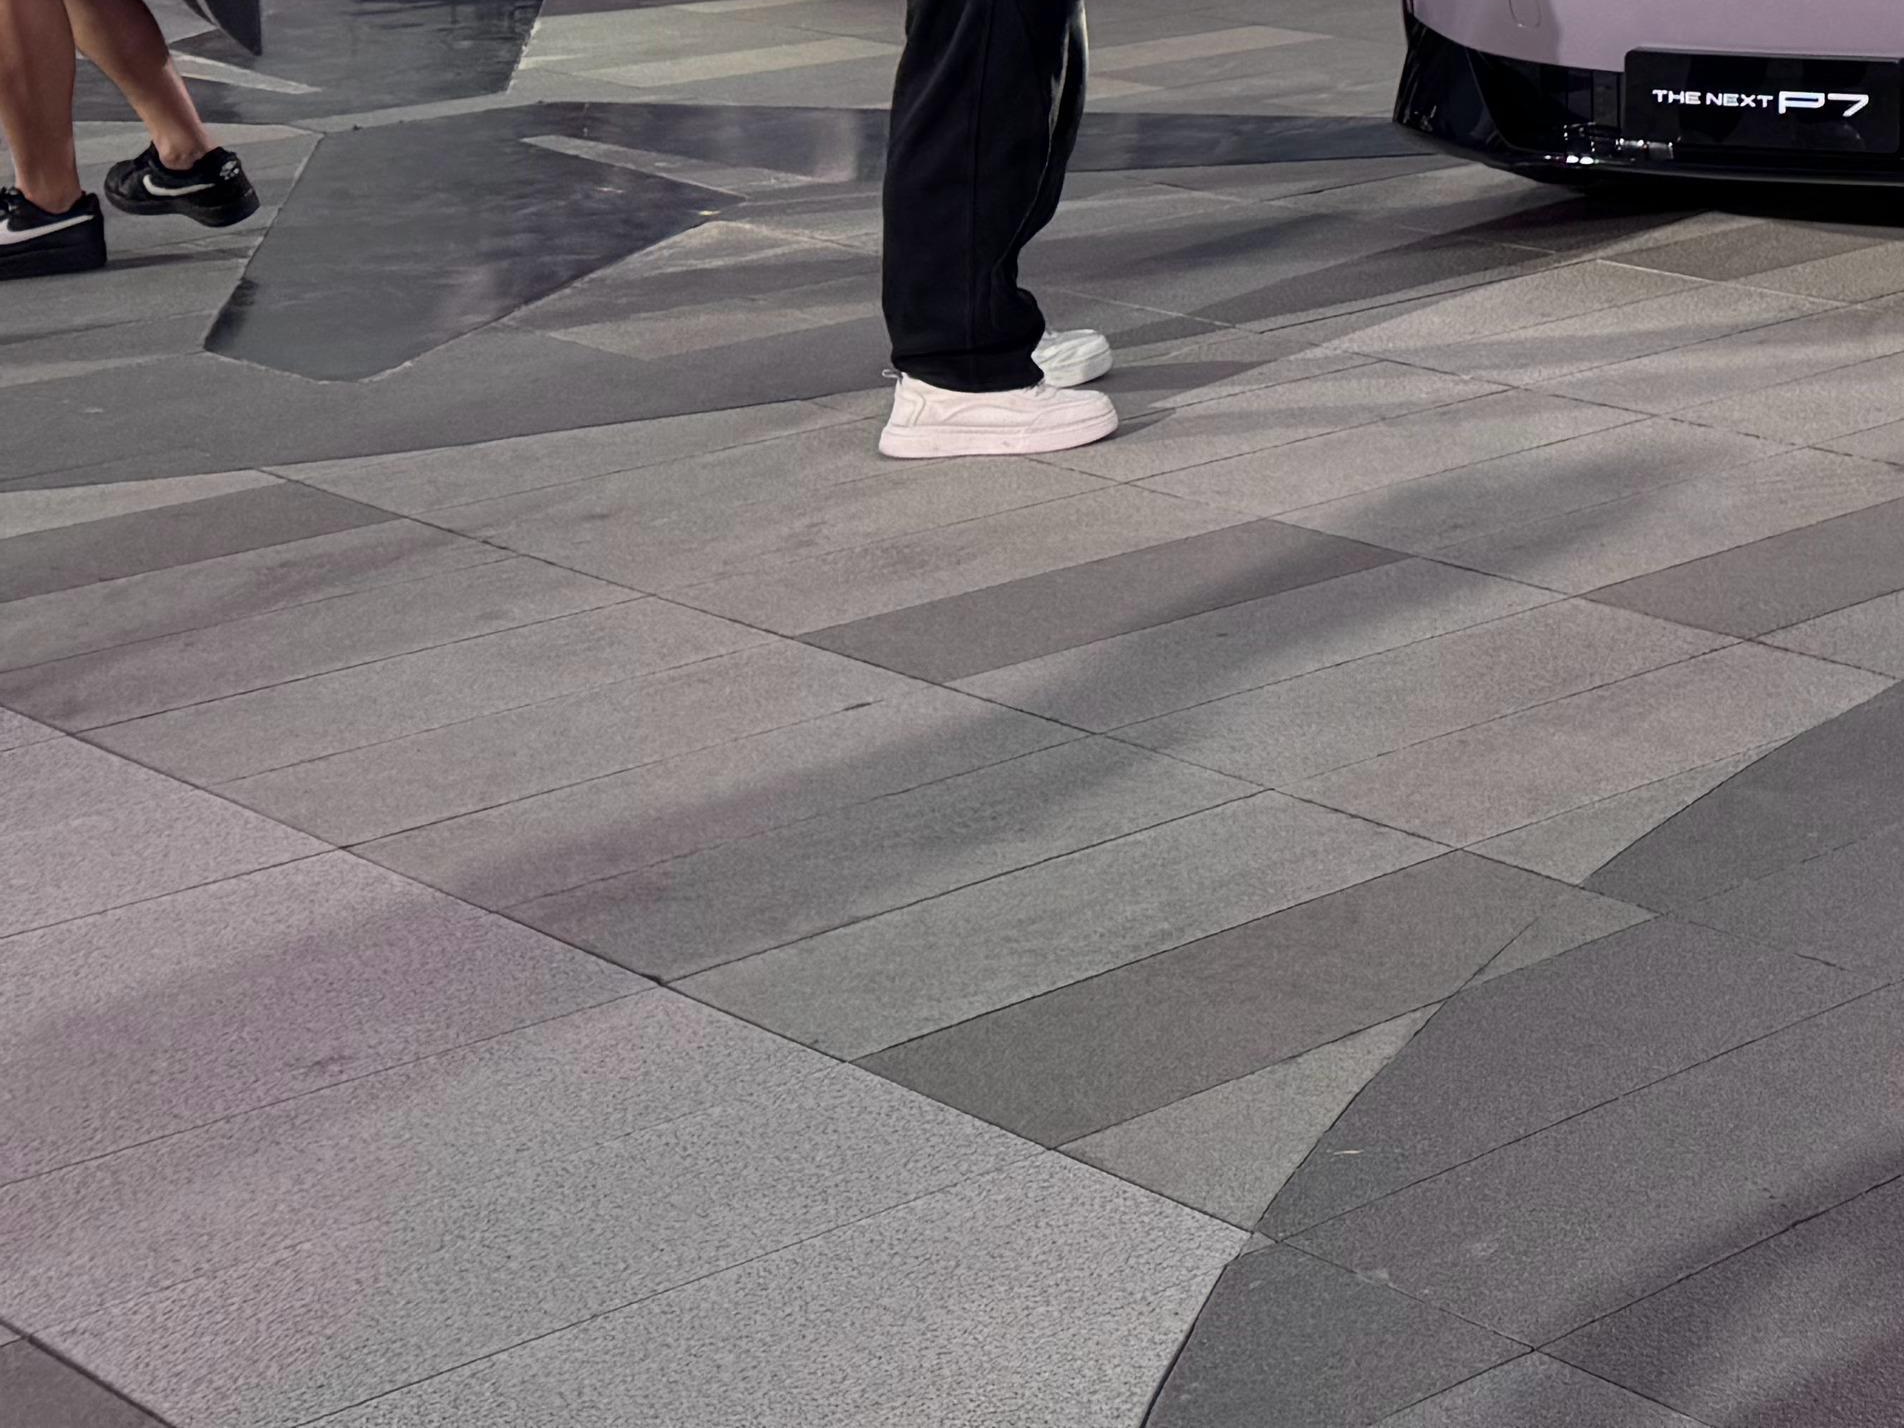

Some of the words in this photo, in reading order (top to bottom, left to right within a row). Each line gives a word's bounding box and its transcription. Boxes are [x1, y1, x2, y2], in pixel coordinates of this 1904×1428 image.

[1652, 89, 1702, 105] THE
[1706, 92, 1774, 108] NEXT
[1778, 91, 1870, 117] P7
